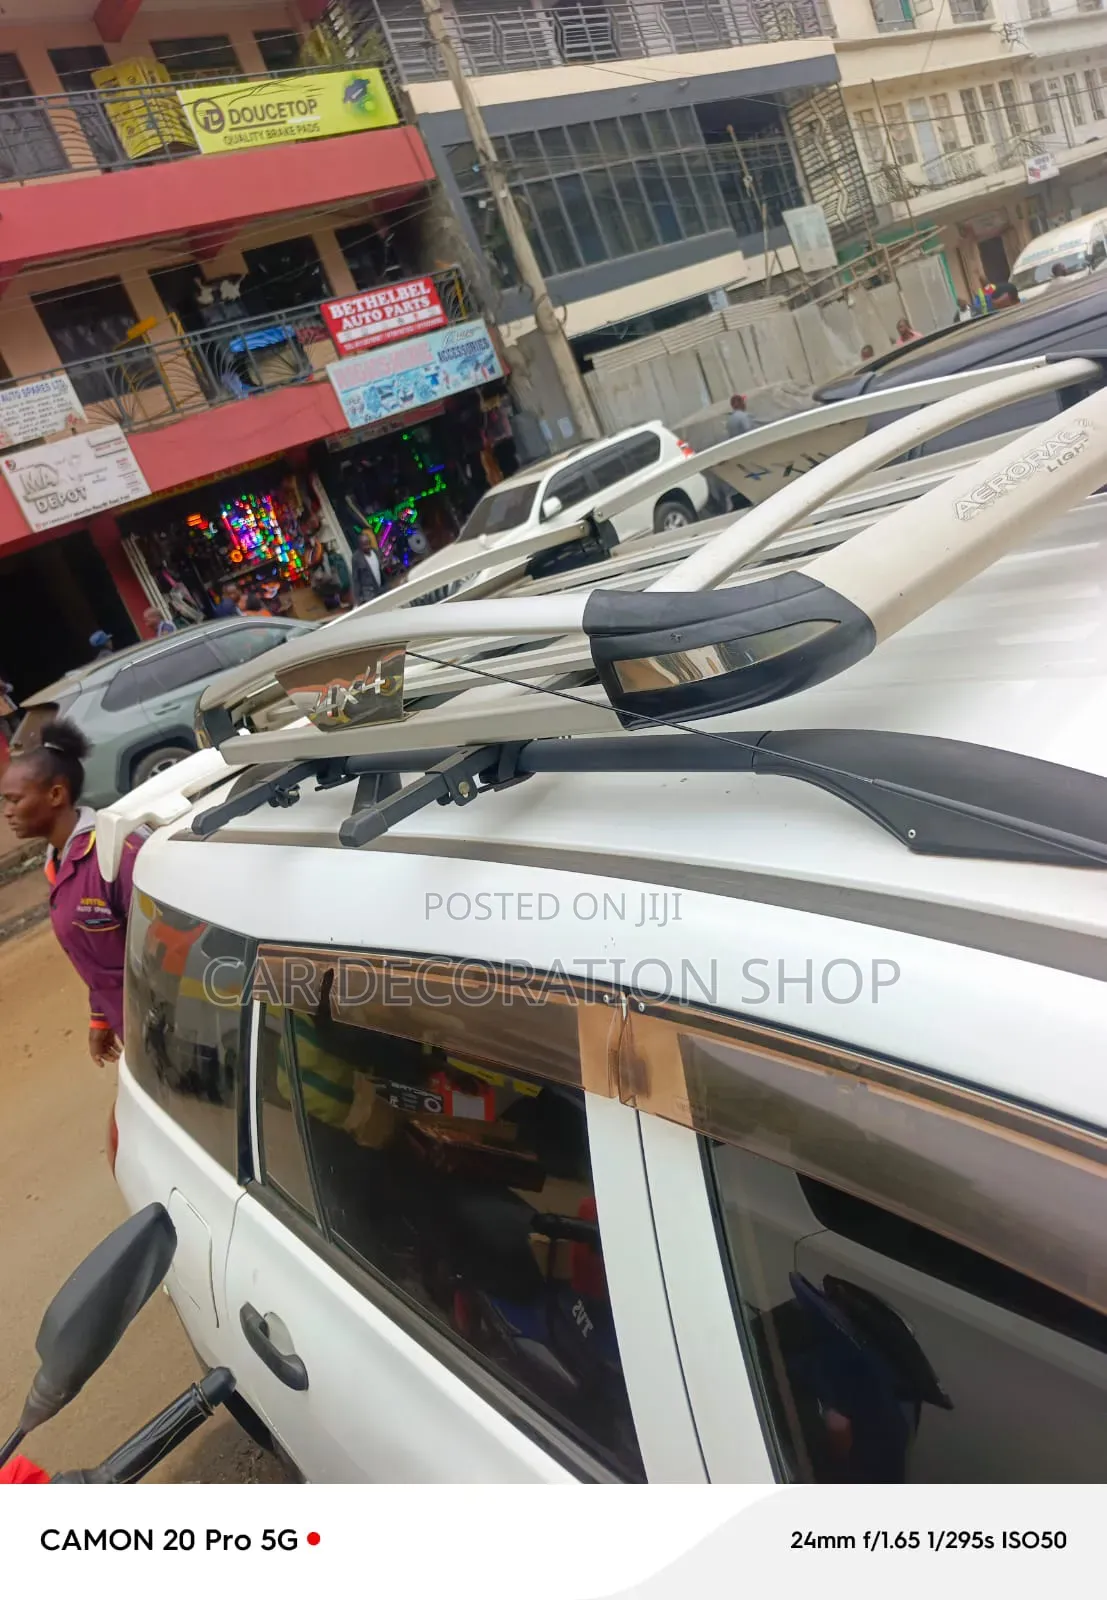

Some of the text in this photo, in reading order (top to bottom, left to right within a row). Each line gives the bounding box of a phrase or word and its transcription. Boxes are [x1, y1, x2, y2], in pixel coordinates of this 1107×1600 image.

[228, 99, 318, 126] DOUCETOP
[223, 123, 321, 146] QUALITY BRAKE PADS
[328, 281, 431, 319] BETHELBEL
[342, 296, 431, 331] AUTO PARTS
[35, 486, 87, 514] DEPOT
